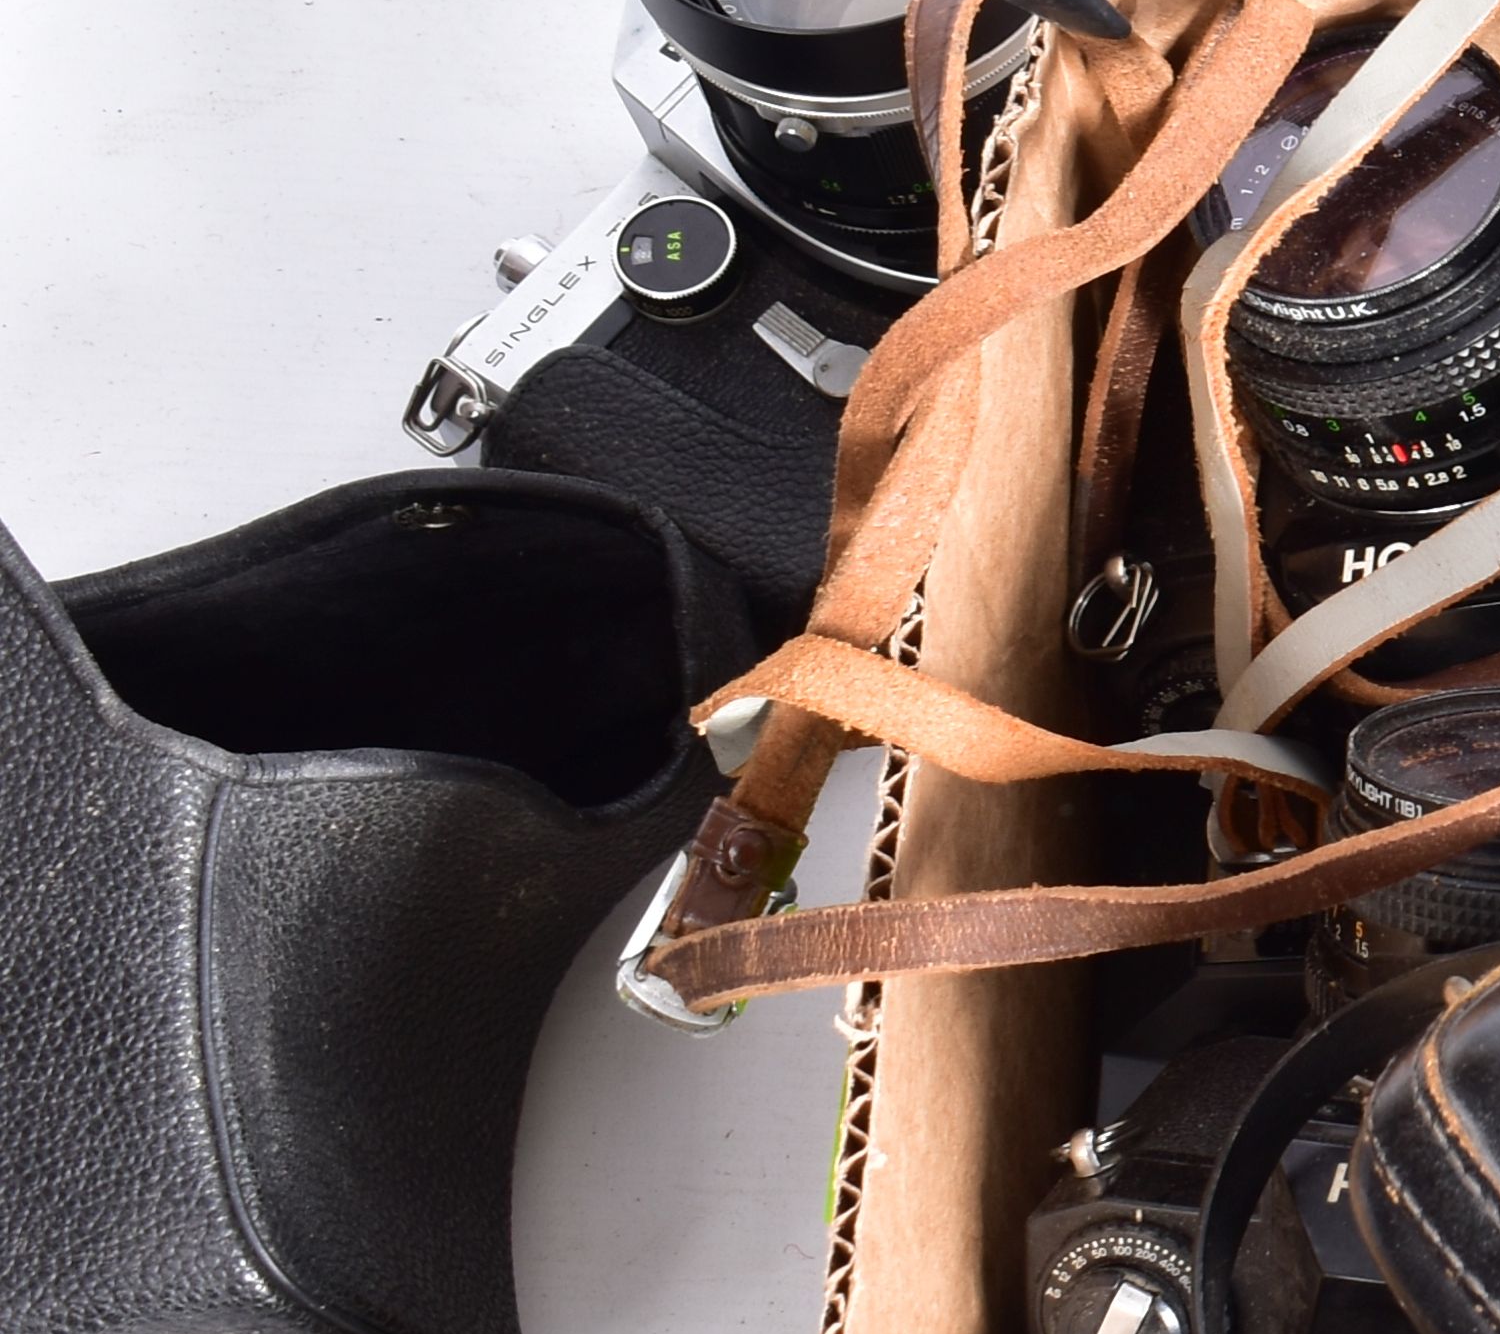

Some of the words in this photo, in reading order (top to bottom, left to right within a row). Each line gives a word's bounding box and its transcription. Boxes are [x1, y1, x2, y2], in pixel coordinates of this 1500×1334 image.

[666, 231, 683, 261] ASA
[484, 255, 597, 368] SINGLEX
[1325, 300, 1379, 320] U.K.
[1414, 410, 1428, 424] 4
[1461, 390, 1476, 406] 5
[1458, 403, 1487, 423] 1.5
[1332, 474, 1351, 490] 11
[1406, 475, 1421, 490] 4
[1451, 465, 1468, 481] 2
[1354, 920, 1365, 940] 5
[1091, 1246, 1108, 1261] 50
[1111, 1244, 1133, 1258] 100
[1134, 1247, 1159, 1264] 200
[1157, 1258, 1183, 1278] 400
